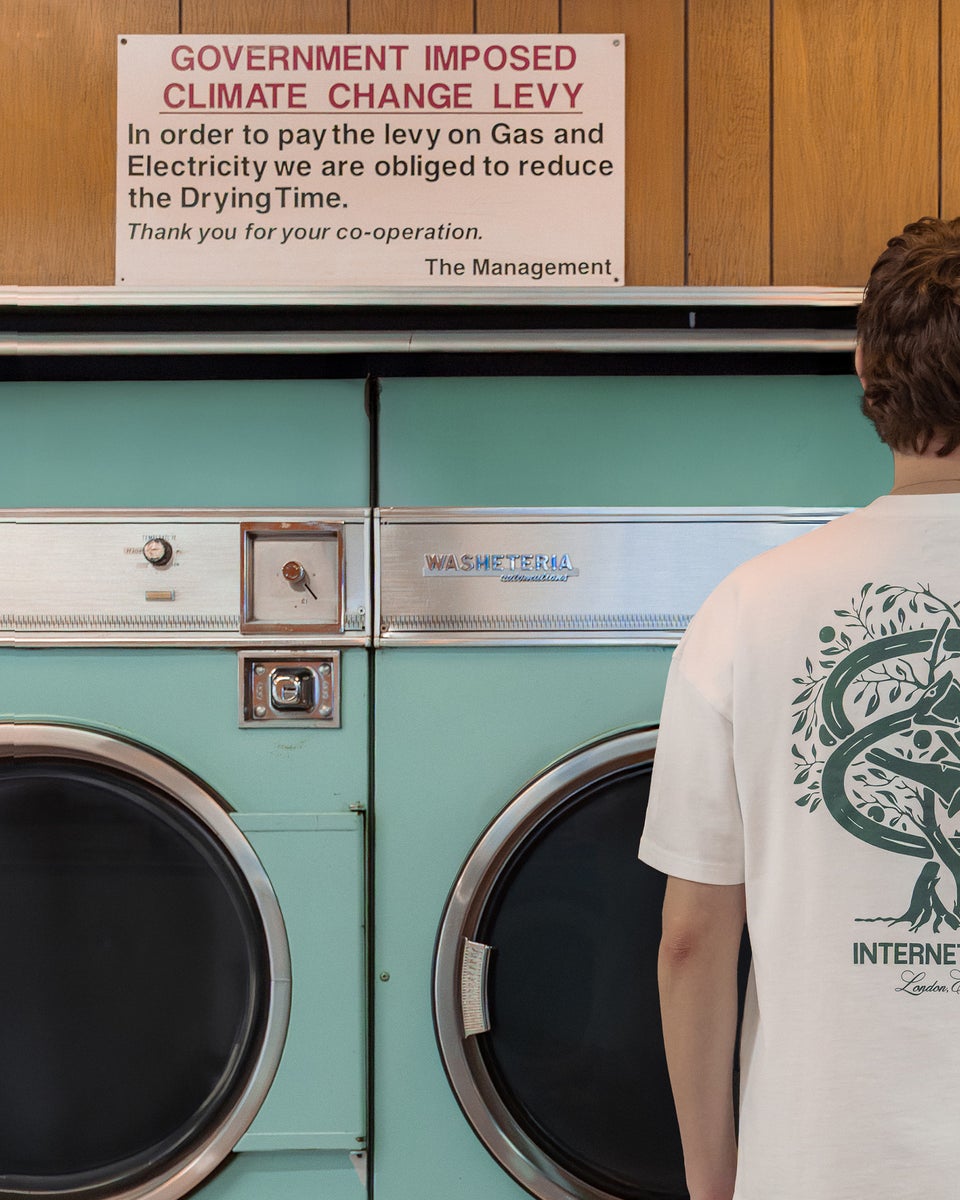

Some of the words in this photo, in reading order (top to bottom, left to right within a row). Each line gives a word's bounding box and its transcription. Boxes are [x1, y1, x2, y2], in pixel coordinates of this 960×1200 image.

[171, 45, 409, 72] GOVERNMENT
[425, 45, 577, 72] IMPOSED
[163, 82, 308, 109] CLIMATE
[328, 82, 473, 110] CHANGE
[493, 82, 584, 109] LEVY
[128, 123, 150, 145] In
[160, 123, 234, 146] order
[242, 124, 269, 145] to
[278, 128, 328, 152] pay
[331, 122, 375, 145] the
[384, 122, 441, 151] levy
[447, 128, 481, 145] on
[490, 122, 544, 145] Gas
[553, 122, 604, 145] and
[127, 154, 268, 183] Electricity
[273, 159, 312, 177] we
[321, 159, 365, 177] are
[374, 154, 475, 183] obliged
[482, 155, 510, 177] to
[519, 154, 614, 177] reduce
[127, 186, 172, 209] the
[181, 186, 271, 215] Drying
[274, 186, 348, 209] Time.
[128, 222, 193, 241] Thank
[196, 227, 237, 245] you
[245, 222, 278, 240] for
[280, 226, 332, 245] your
[336, 222, 483, 245] co-operation.
[424, 258, 466, 276] The
[472, 258, 612, 280] Management
[424, 552, 574, 571] WASHETERIA
[894, 969, 949, 996] London,
